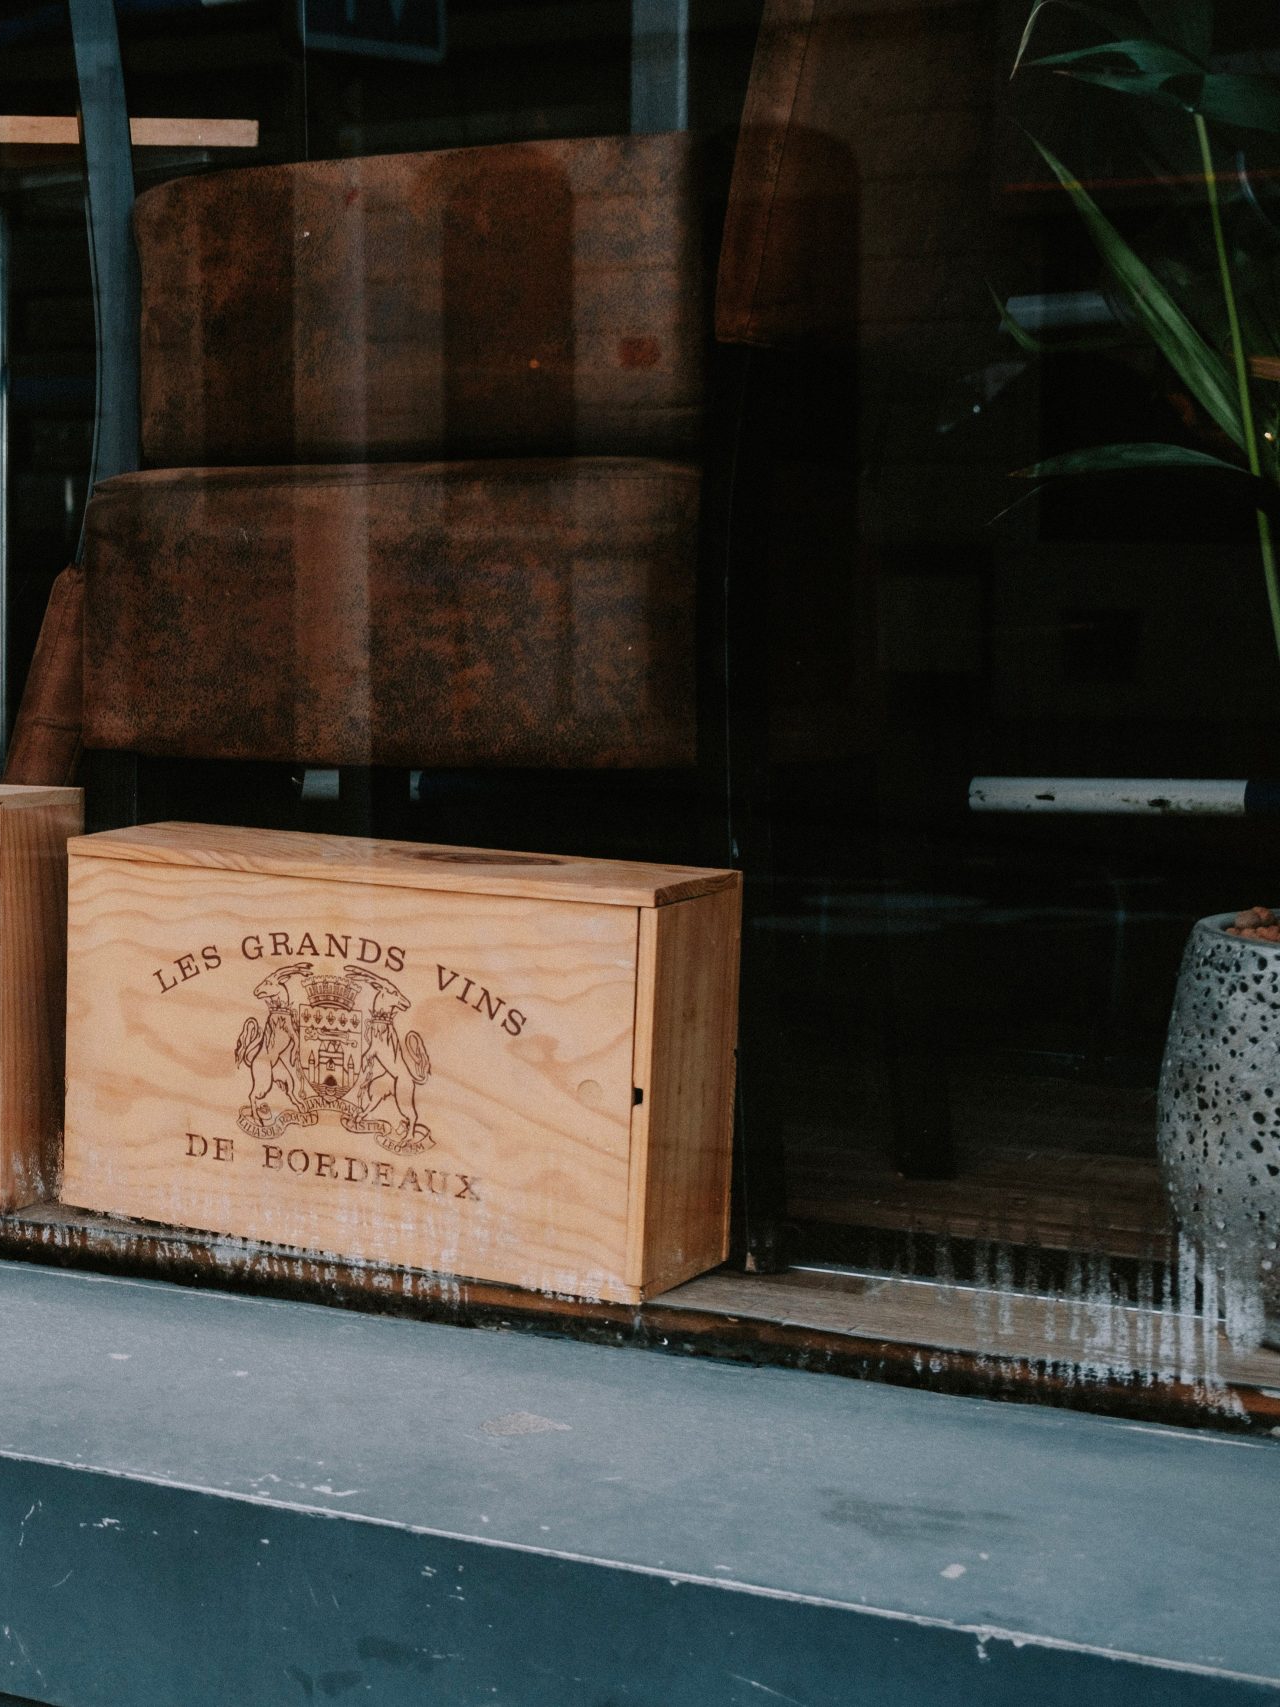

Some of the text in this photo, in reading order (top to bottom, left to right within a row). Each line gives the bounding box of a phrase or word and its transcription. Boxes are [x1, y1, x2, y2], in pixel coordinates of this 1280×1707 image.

[153, 931, 528, 1037] LES GRANDS VINS
[185, 1132, 482, 1202] DE BORDEAUX
